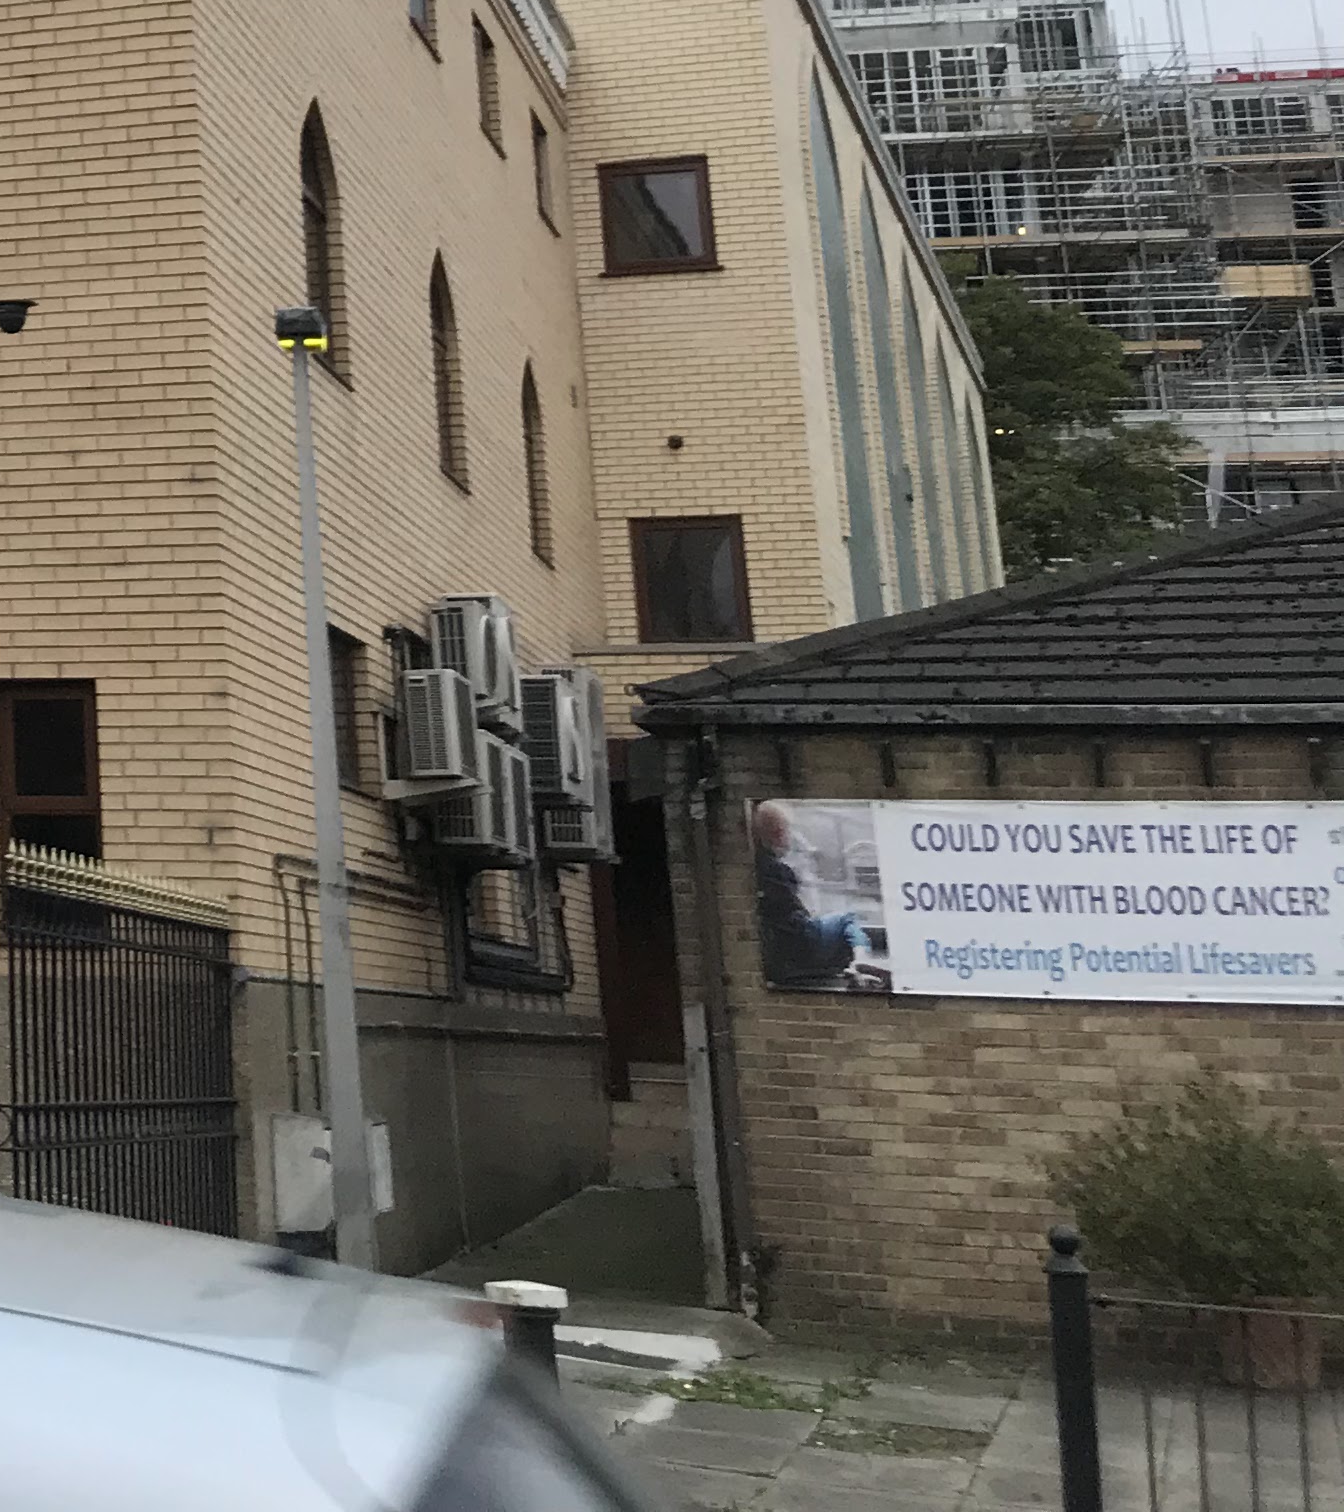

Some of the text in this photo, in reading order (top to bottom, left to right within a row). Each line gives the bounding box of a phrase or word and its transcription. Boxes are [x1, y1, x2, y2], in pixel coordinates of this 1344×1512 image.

[912, 823, 1000, 852] COULD
[1004, 824, 1062, 853] YOU
[1068, 824, 1137, 853] SAVE
[1140, 824, 1195, 854] THE
[1199, 824, 1257, 854] LIFE
[1262, 824, 1298, 854] OF
[901, 882, 1330, 916] SOMEONE WITH BLOOD CANCER?
[925, 939, 1316, 981] Registering Potential Lifesavers
